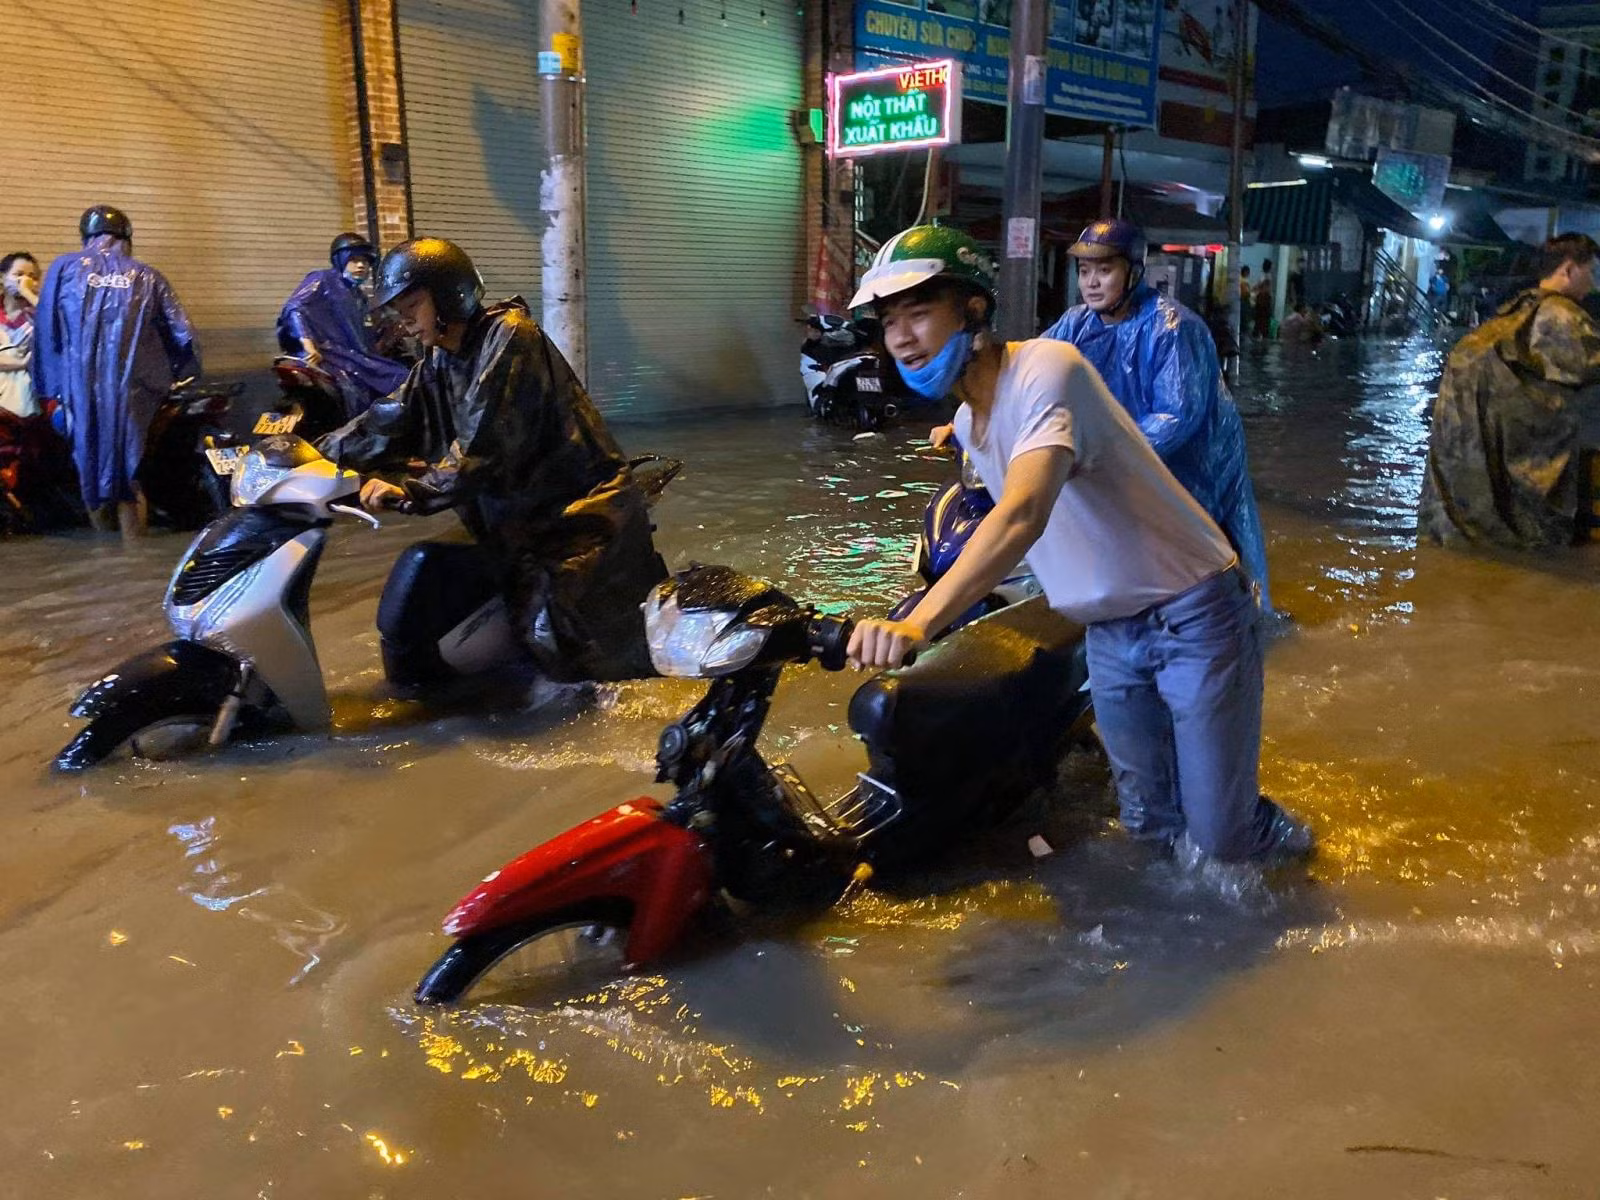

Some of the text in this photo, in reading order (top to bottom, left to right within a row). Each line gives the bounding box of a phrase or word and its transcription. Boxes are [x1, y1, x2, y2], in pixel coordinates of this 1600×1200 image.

[850, 87, 927, 120] NỘI THẤT
[844, 118, 887, 145] XUẤT
